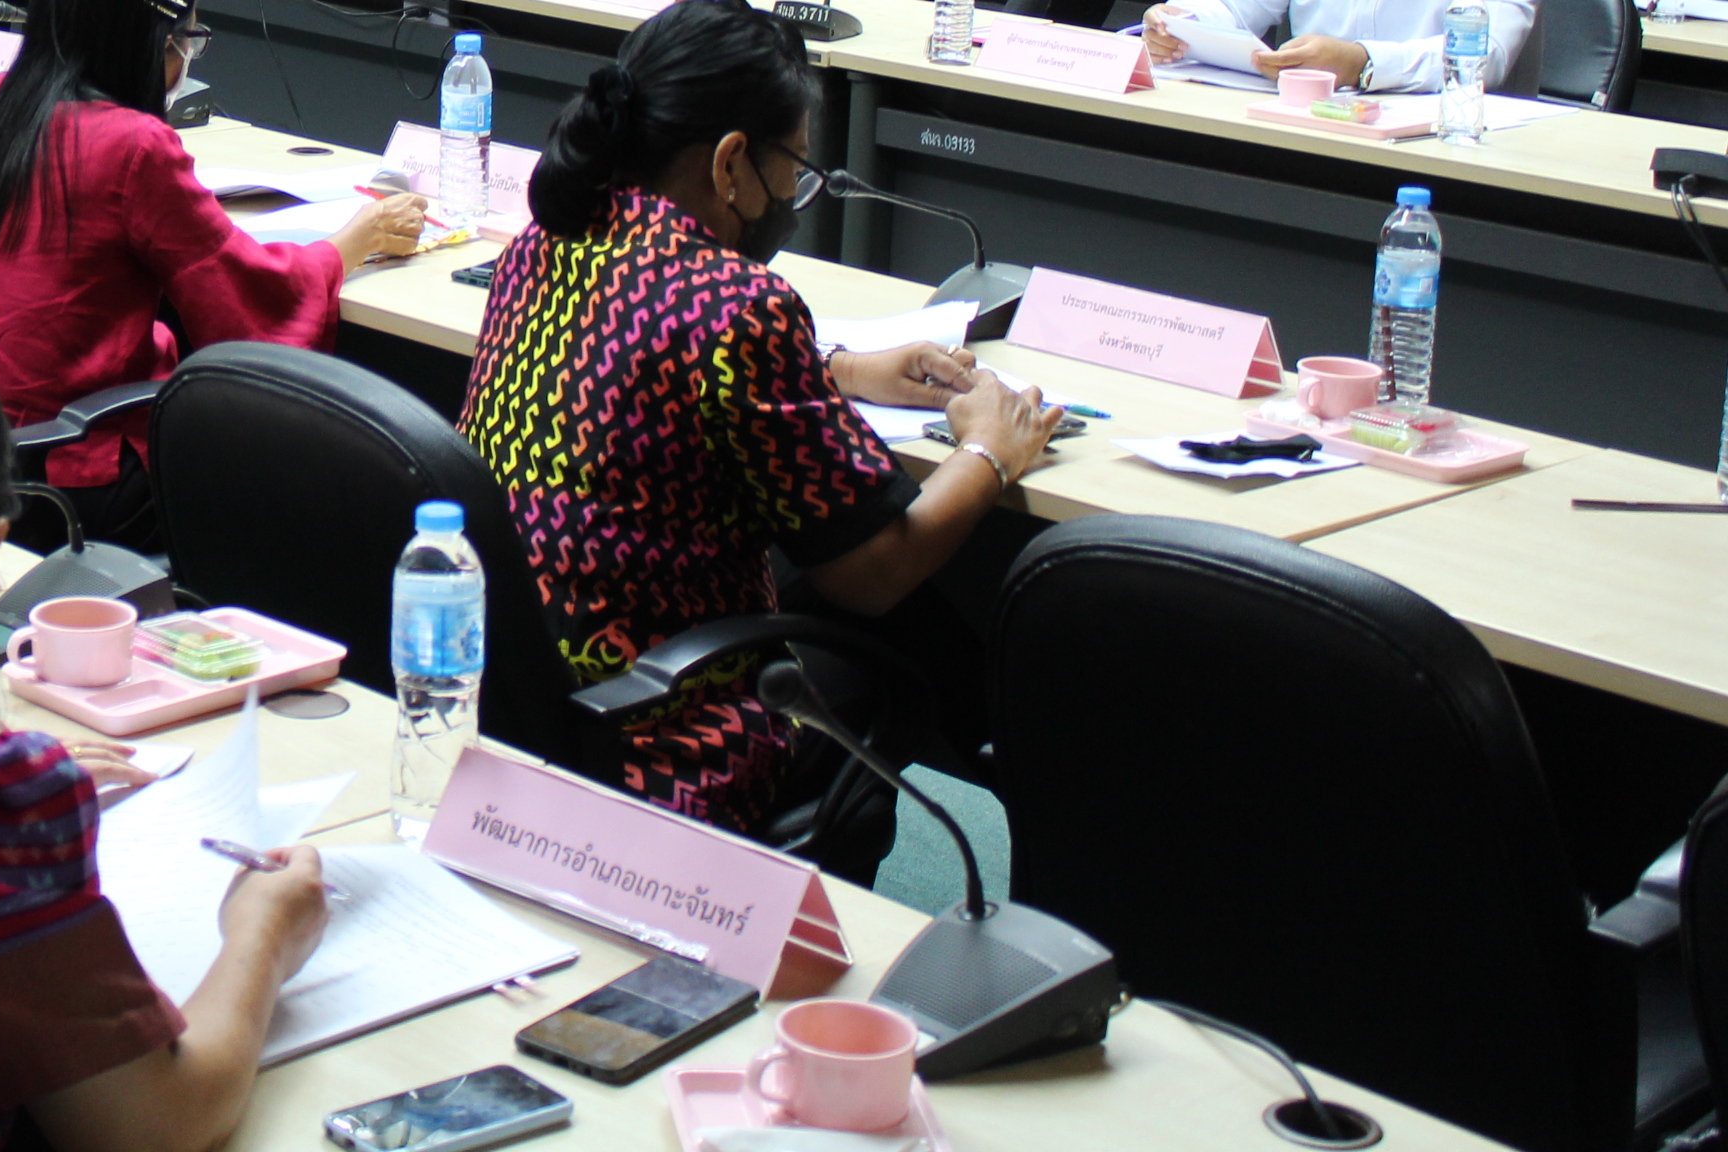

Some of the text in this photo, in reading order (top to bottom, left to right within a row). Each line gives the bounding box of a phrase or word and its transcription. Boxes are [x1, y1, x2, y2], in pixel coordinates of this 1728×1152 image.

[1060, 292, 1225, 342] ประธานคณะกรรมการพัฒนาสตรี
[1098, 330, 1164, 362] จังหวัดชลบุรี
[470, 804, 754, 937] พัฒนาการอำเภอเกาะจันทร์
